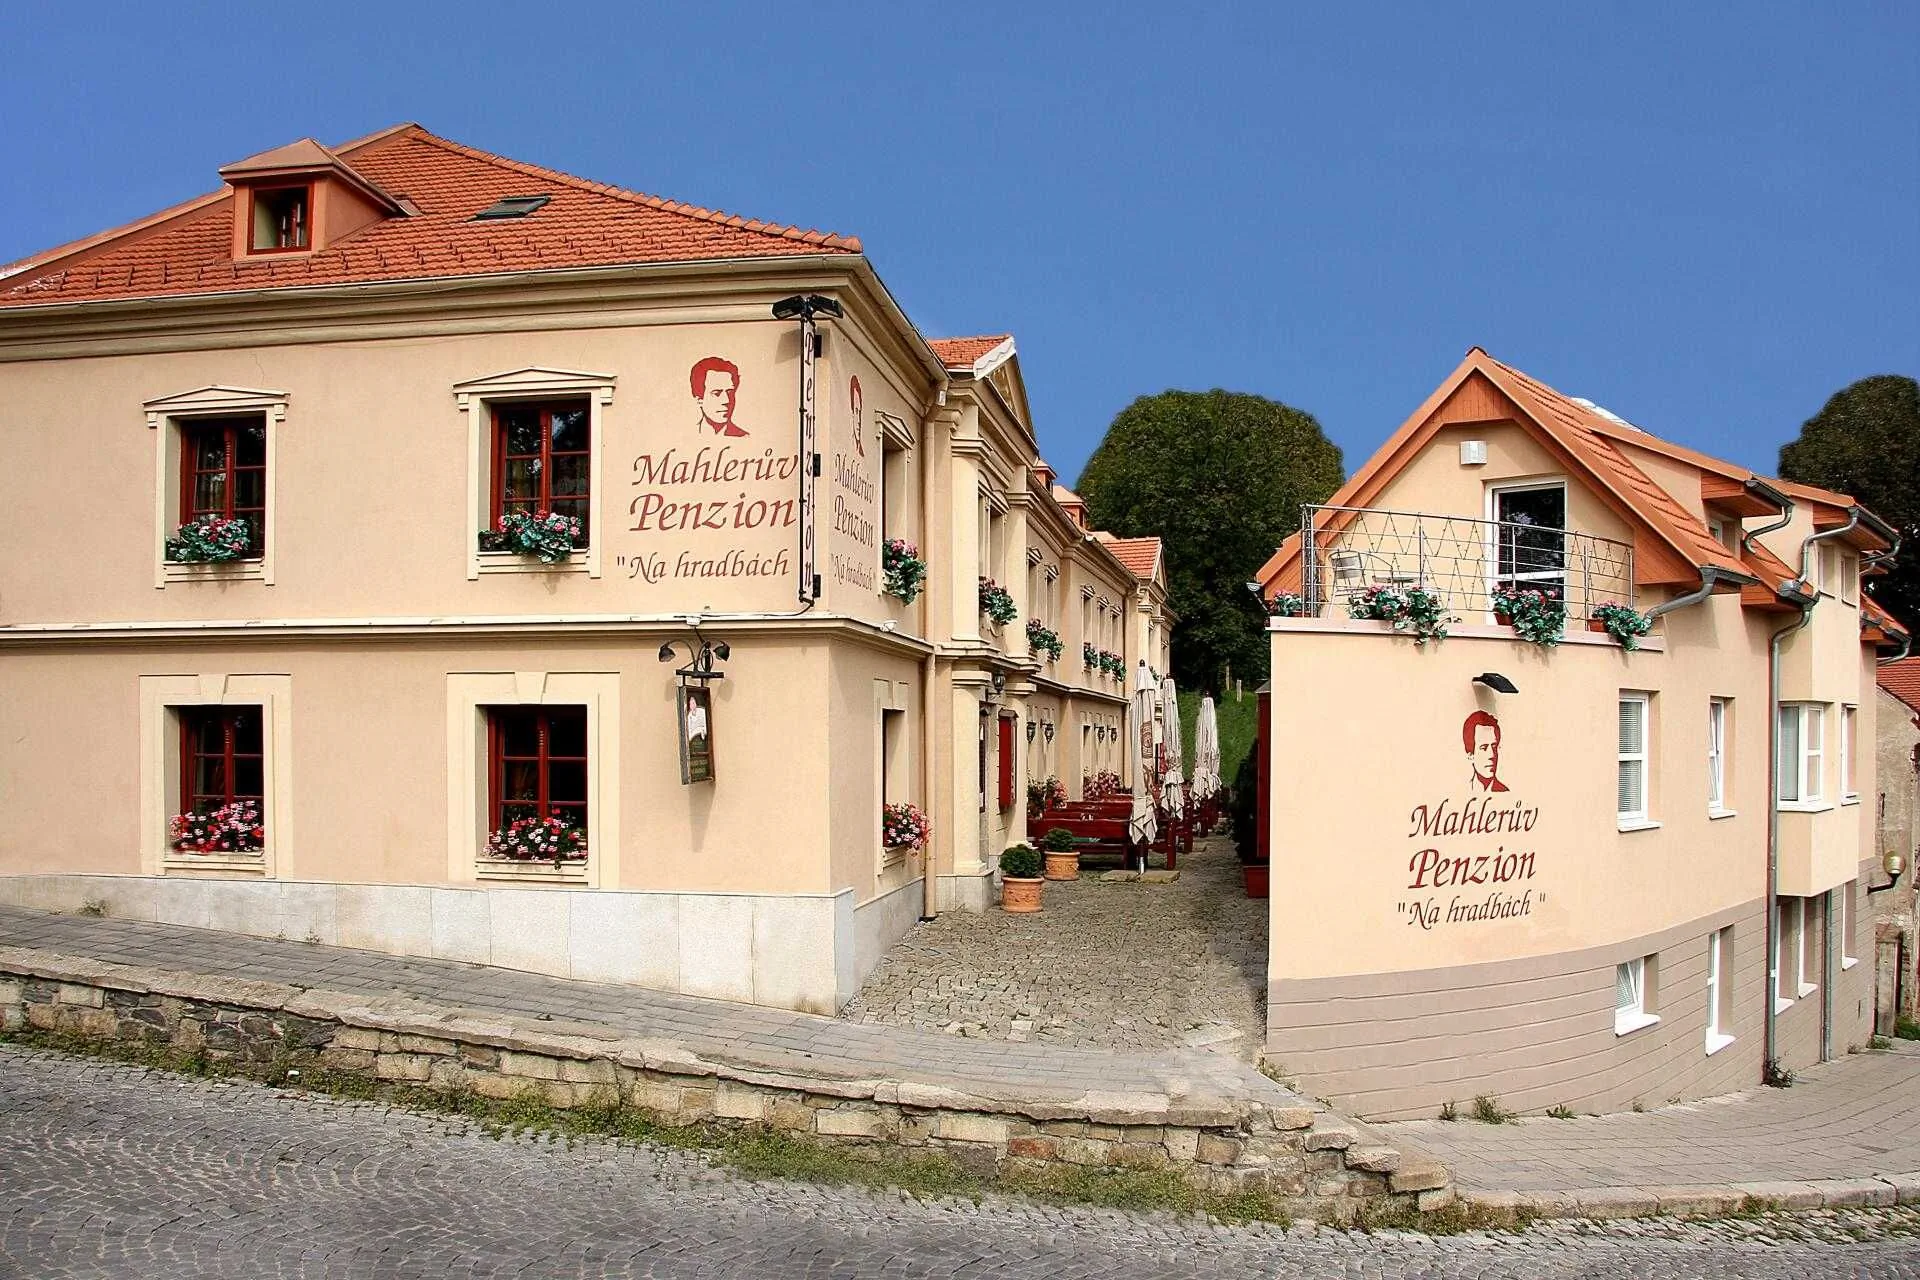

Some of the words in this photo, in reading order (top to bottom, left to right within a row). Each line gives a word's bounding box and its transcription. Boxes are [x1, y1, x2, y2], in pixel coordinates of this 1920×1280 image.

[632, 446, 798, 485] Mahlerův
[629, 492, 797, 531] Penzion
[834, 494, 874, 548] Penzion
[674, 549, 789, 578] hradbách
[1408, 796, 1538, 838] Mahlerův
[1407, 846, 1536, 889] Penzion
